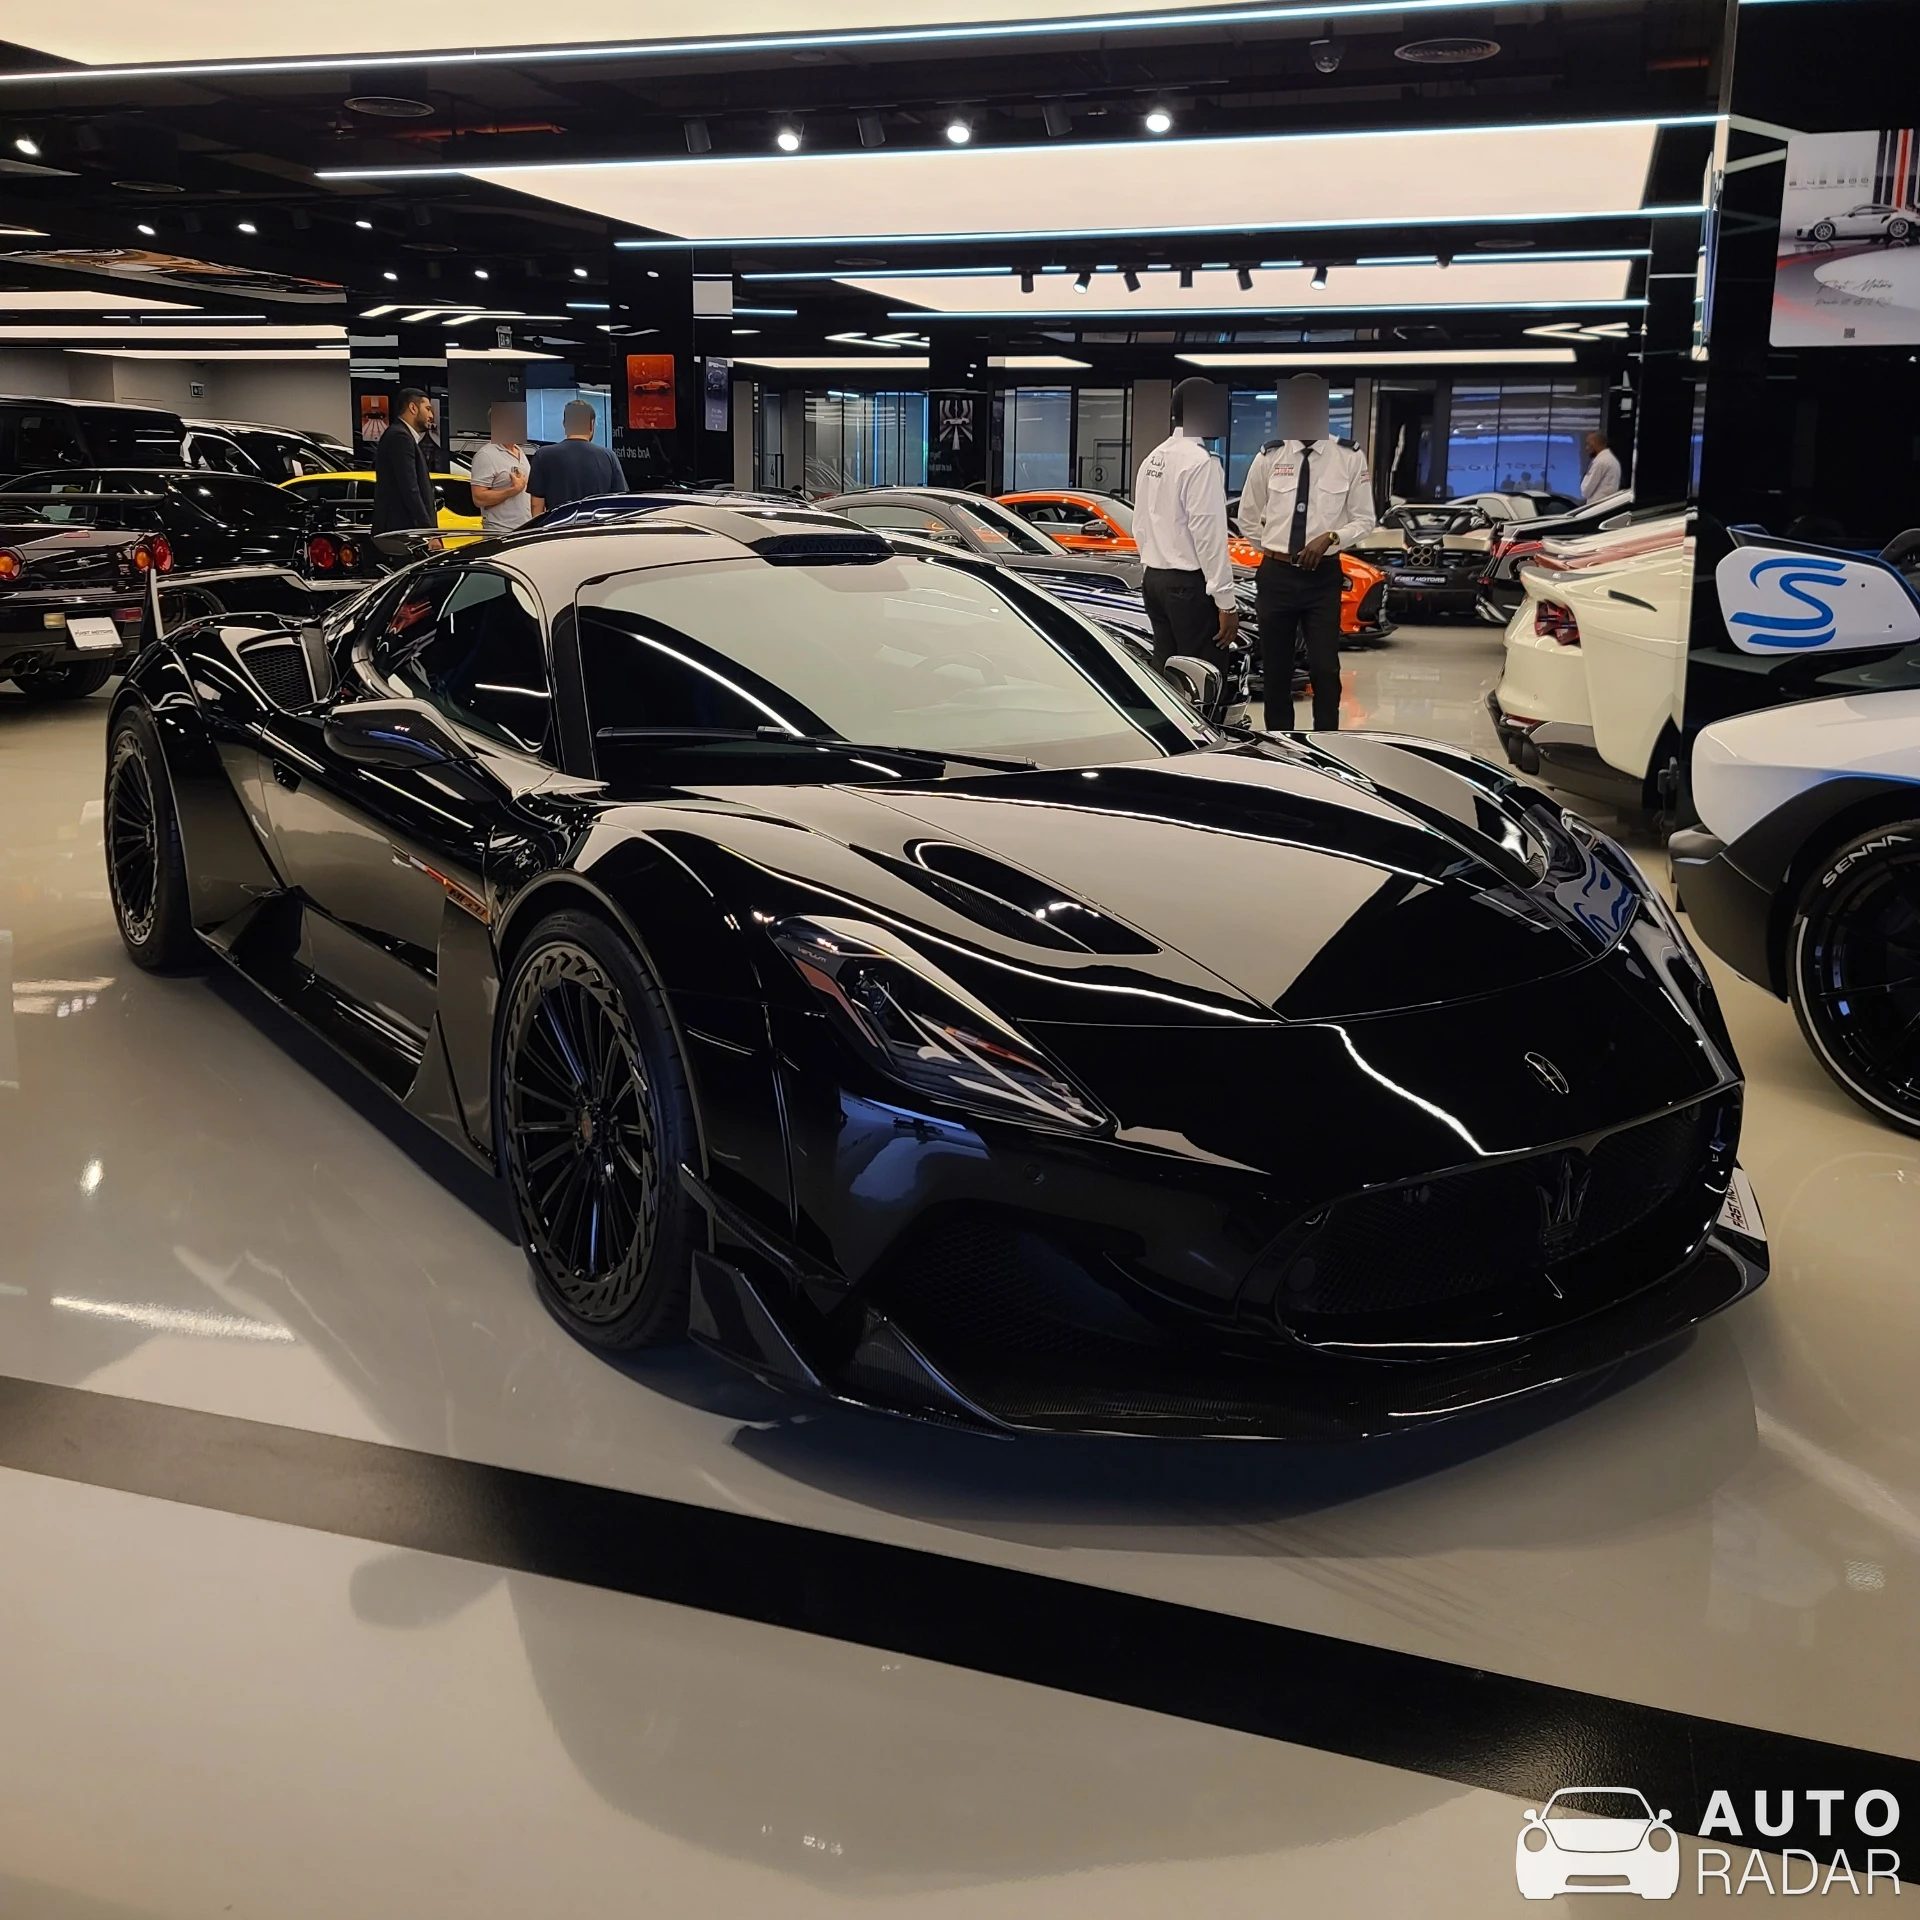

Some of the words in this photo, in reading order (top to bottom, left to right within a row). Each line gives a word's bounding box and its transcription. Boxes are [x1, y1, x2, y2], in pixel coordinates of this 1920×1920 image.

[1094, 467, 1103, 482] 3
[1822, 835, 1913, 889] SENNA
[1725, 1200, 1746, 1230] FIRST
